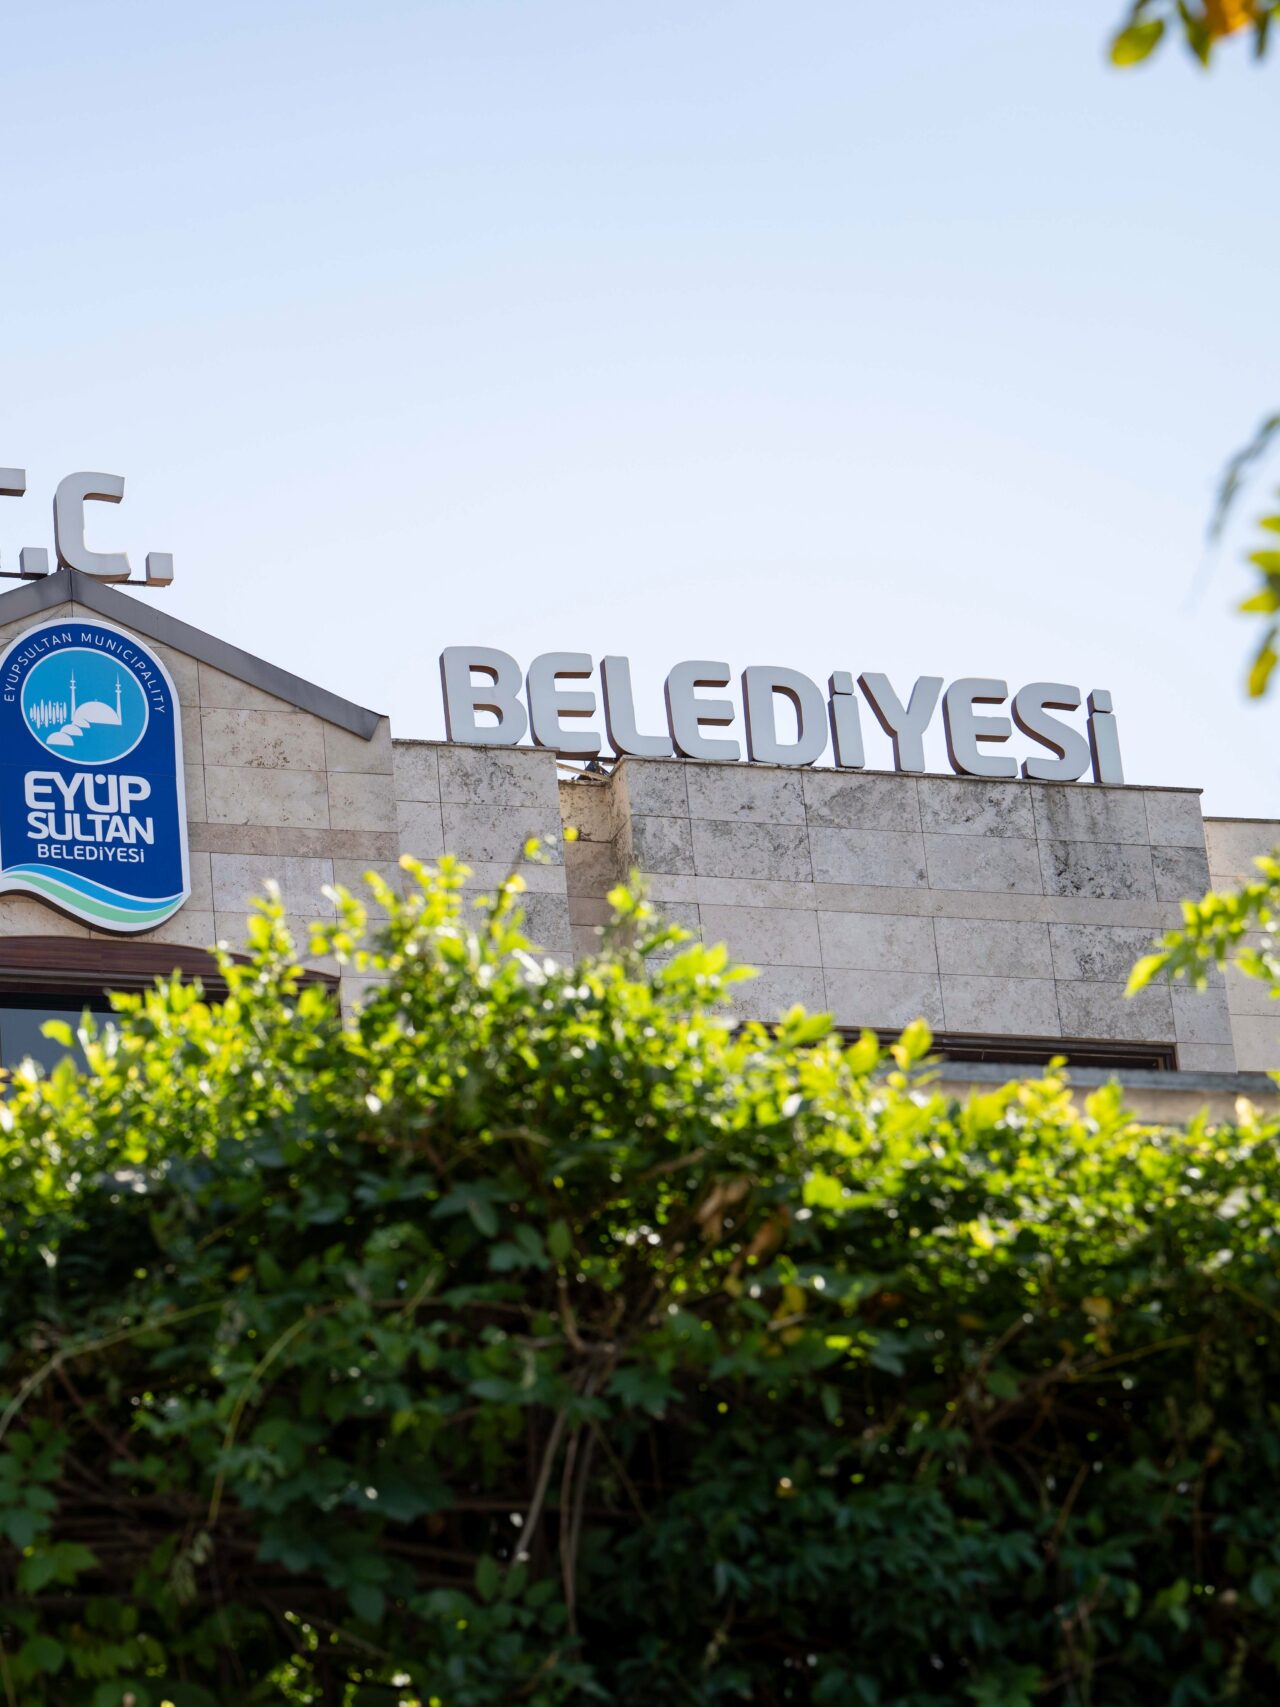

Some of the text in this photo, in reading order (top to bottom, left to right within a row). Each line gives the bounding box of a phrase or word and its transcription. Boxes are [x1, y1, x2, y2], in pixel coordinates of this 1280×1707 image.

[3, 632, 165, 713] EYUPSULTAN MUNICIPALITY
[27, 812, 154, 845] SULTAN
